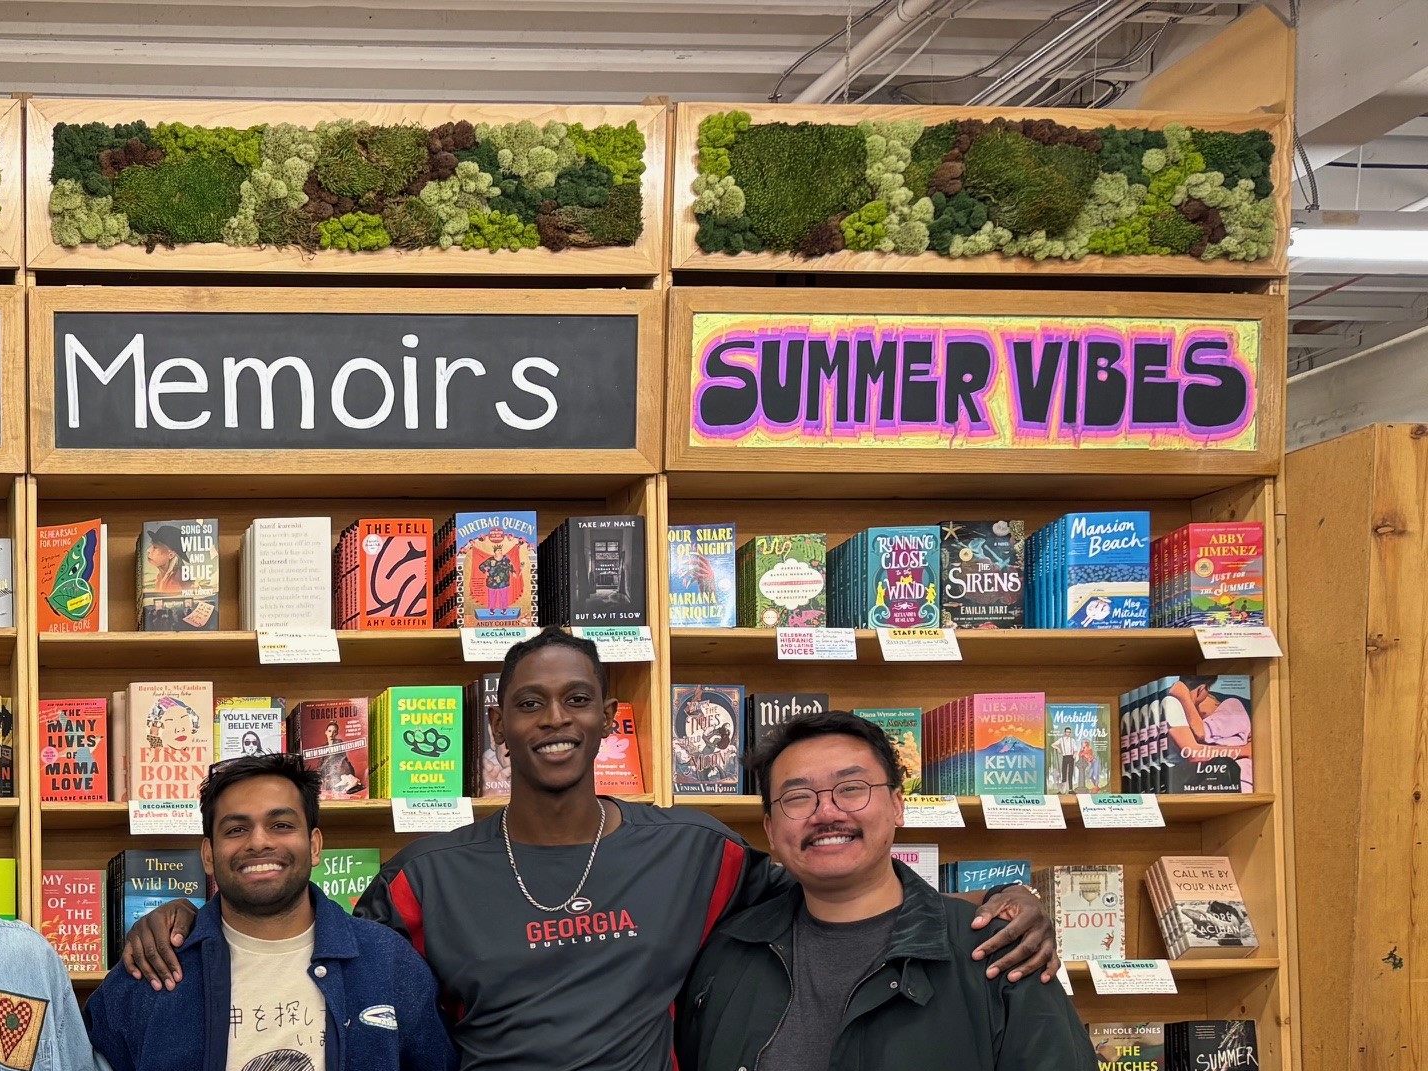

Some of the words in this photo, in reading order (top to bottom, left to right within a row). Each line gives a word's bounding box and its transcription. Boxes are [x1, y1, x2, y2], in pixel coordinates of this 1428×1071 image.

[65, 334, 560, 430] Memoirs
[699, 340, 991, 426] SUMMER
[1013, 340, 1247, 426] VIBES
[181, 524, 199, 534] SONG
[202, 524, 212, 533] SO
[366, 524, 391, 535] THE
[396, 523, 427, 534] TELL
[1071, 518, 1135, 538] Mansion
[181, 536, 213, 553] WILD
[878, 535, 933, 552] RUNNING
[1089, 535, 1144, 556] Beach
[1210, 533, 1245, 544] ABBY
[1199, 545, 1257, 557] JIMENEZ
[190, 554, 204, 563] AND
[881, 550, 928, 568] CLOSE
[181, 565, 213, 581] BLUE
[946, 567, 1021, 598] SIRENS
[884, 581, 924, 600] WIND
[397, 698, 456, 711] SUCKER
[47, 719, 95, 732] MANY
[400, 712, 453, 725] PUNCH
[48, 734, 95, 748] LIVES
[1180, 746, 1241, 760] Ordinary
[45, 761, 99, 775] MAMA
[985, 755, 1035, 769] KEVIN
[1197, 760, 1226, 774] Love
[51, 777, 92, 791] LOVE
[984, 770, 1037, 784] KWAN
[145, 859, 183, 870] Three
[1173, 870, 1195, 878] CALL
[1218, 871, 1228, 879] BY
[65, 884, 95, 894] SIDE
[131, 878, 163, 891] Wild
[168, 878, 198, 893] Dogs
[1177, 883, 1204, 891] YOUR
[526, 909, 635, 943] GEORGIA
[1064, 913, 1116, 928] LOOT
[59, 925, 98, 935] RIVER
[1115, 1046, 1140, 1056] THE
[1099, 1062, 1158, 1071] WITCHES
